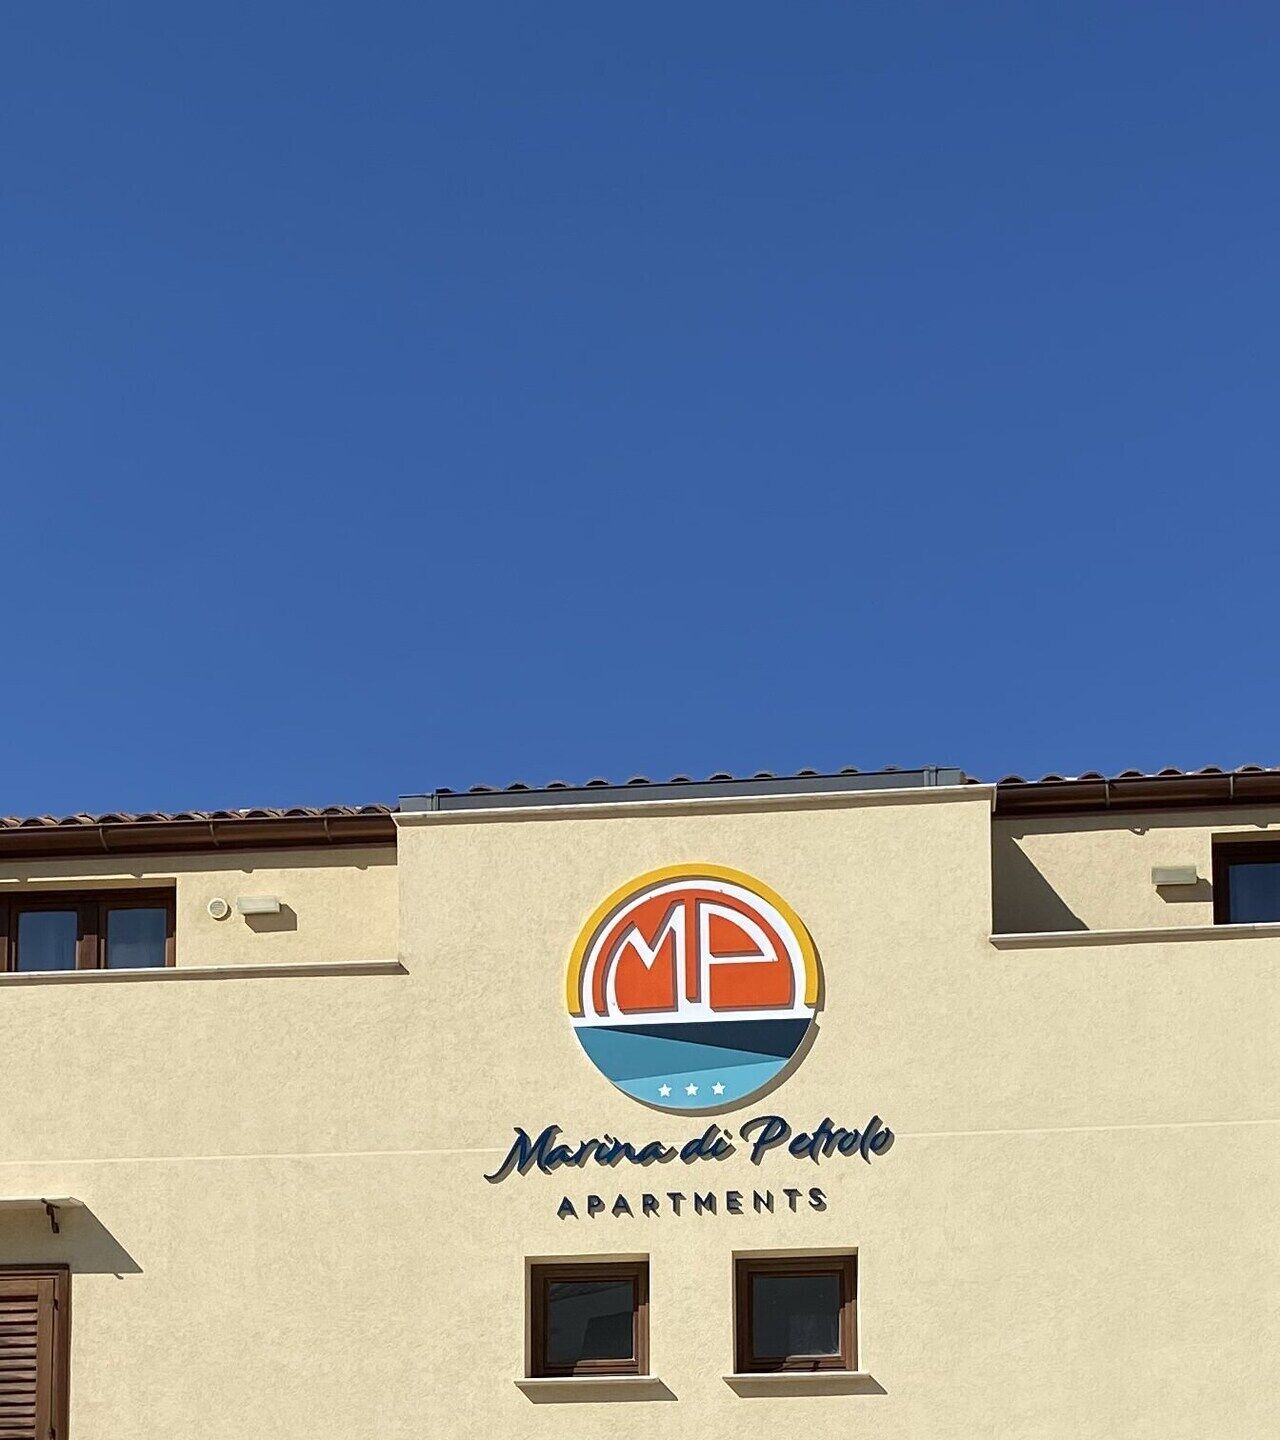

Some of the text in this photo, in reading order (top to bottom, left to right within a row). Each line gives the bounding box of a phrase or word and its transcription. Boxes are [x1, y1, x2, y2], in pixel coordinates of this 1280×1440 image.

[484, 1114, 895, 1184] Marina di Petrolo
[556, 1187, 828, 1220] APARTMENTS
